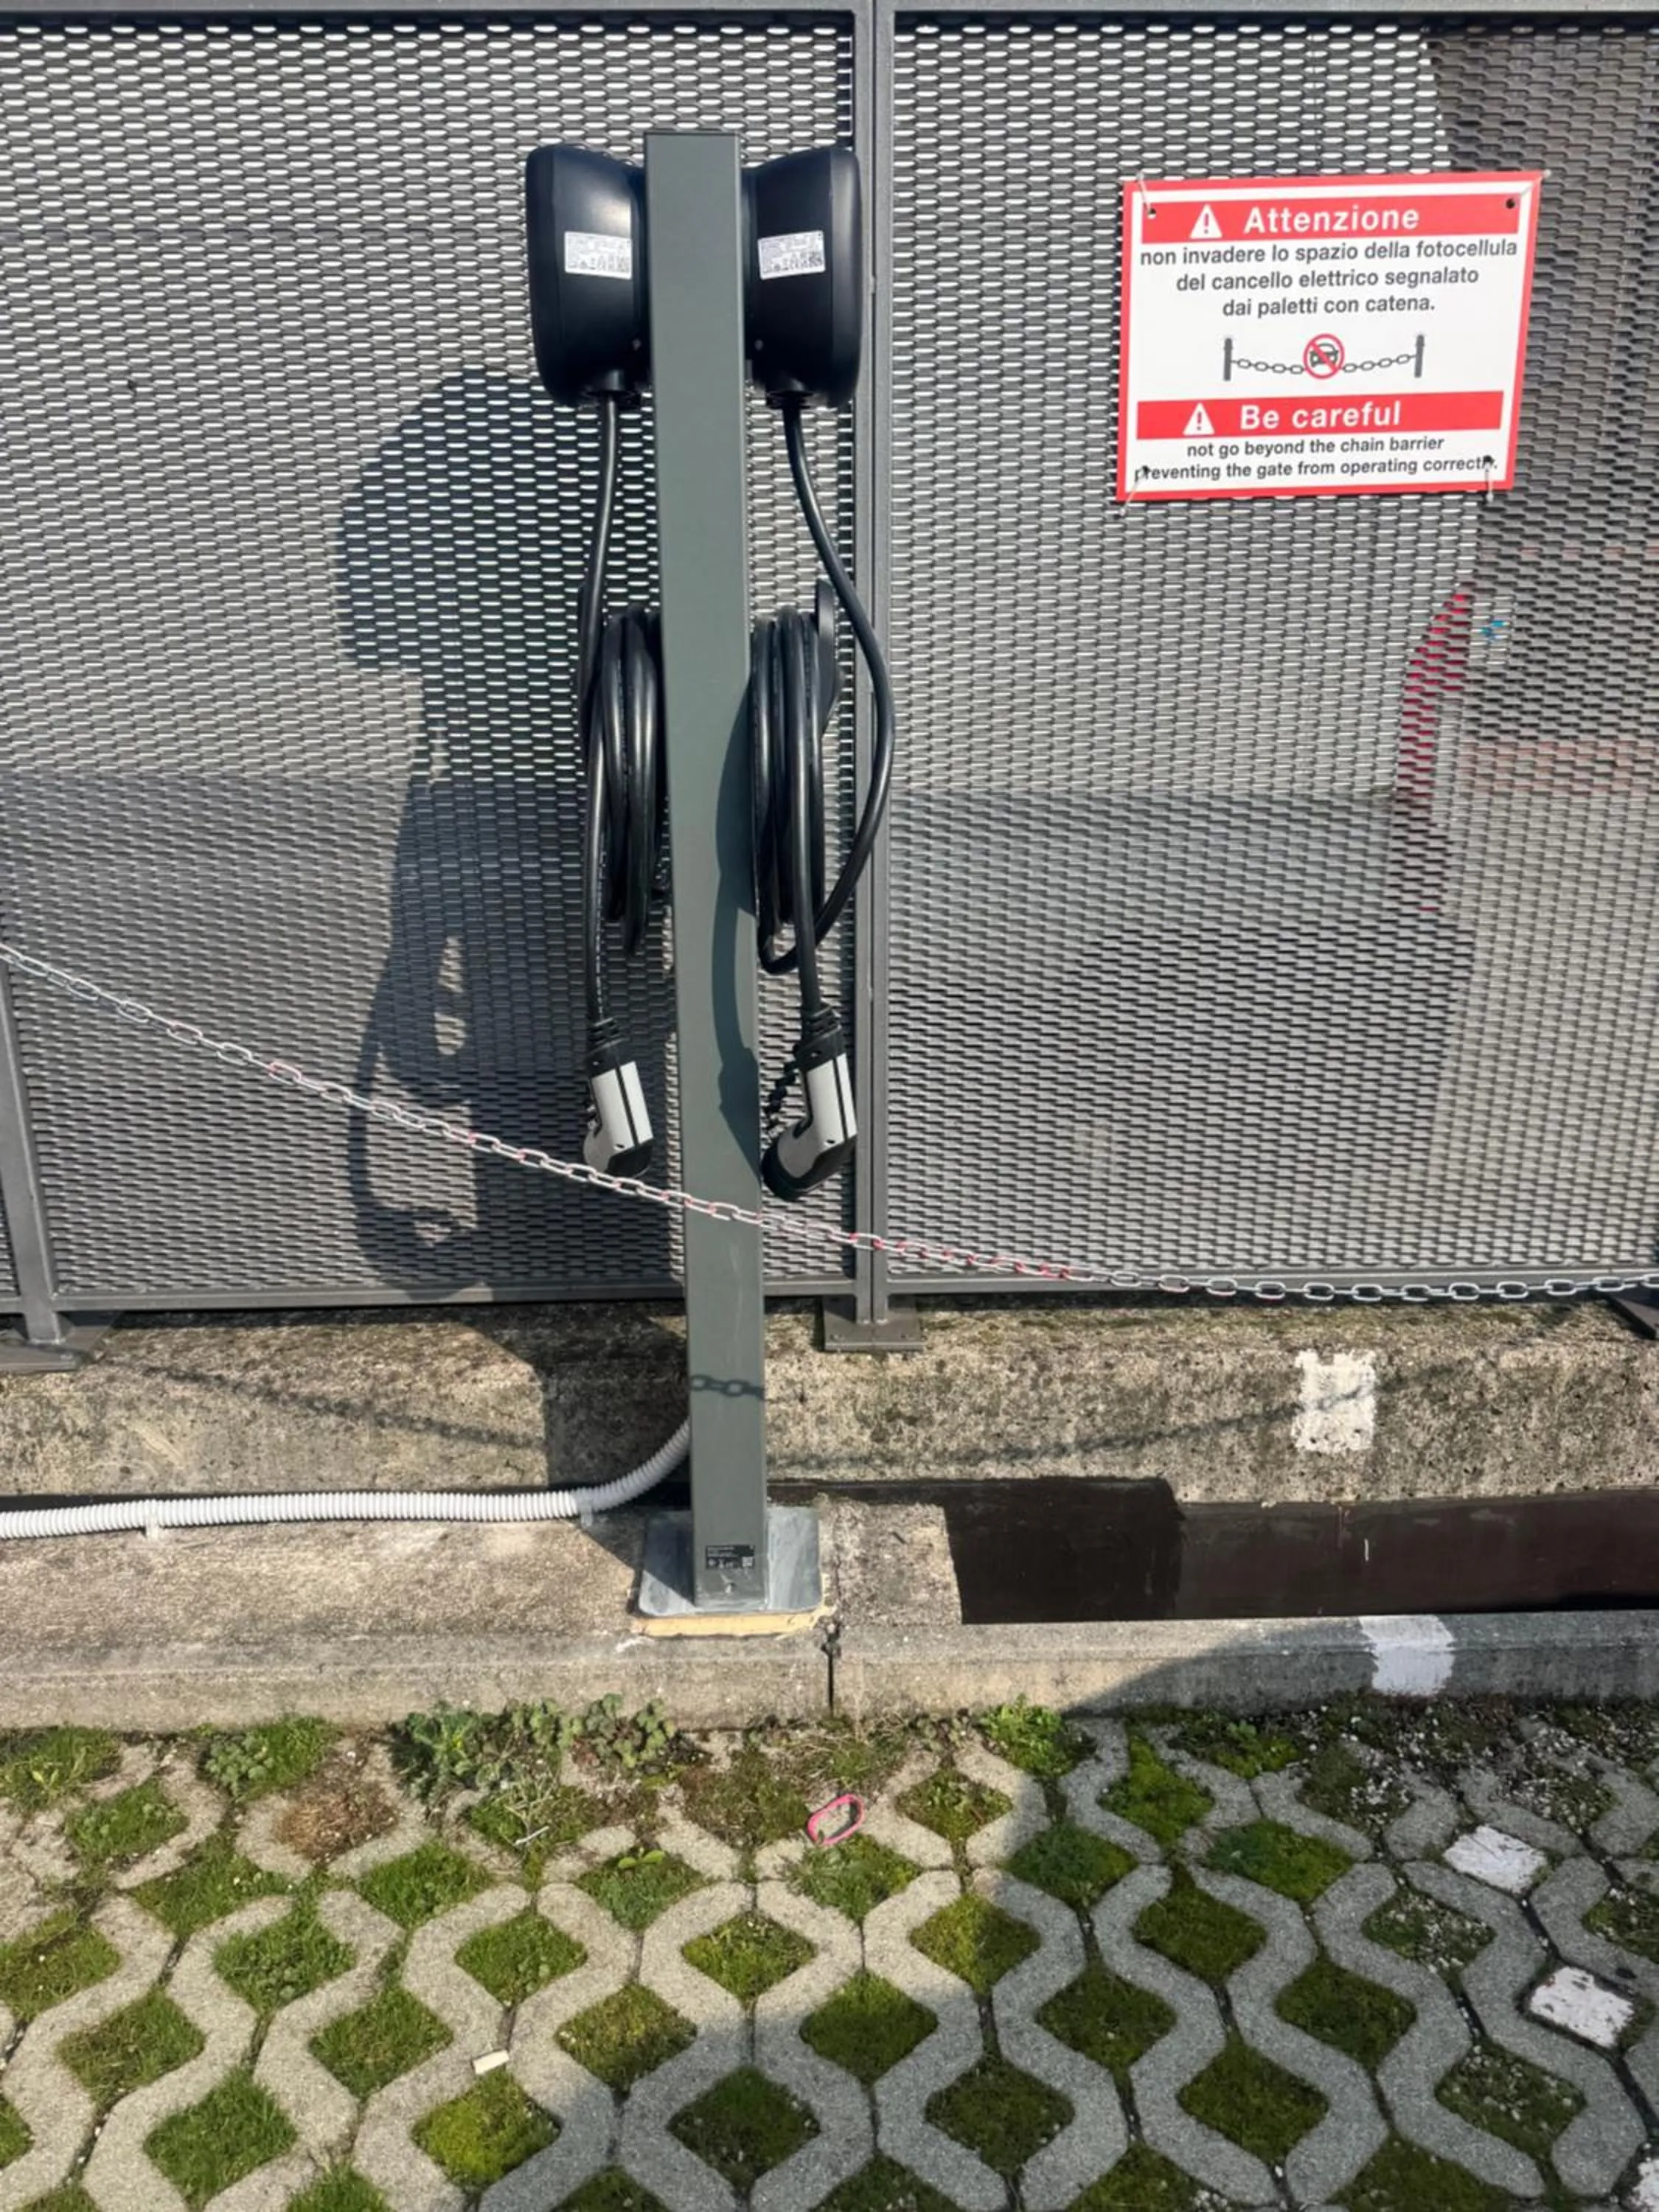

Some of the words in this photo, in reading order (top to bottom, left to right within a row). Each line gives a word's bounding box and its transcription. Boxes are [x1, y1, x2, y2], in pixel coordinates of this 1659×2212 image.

[1243, 205, 1420, 234] Attenzione
[1141, 251, 1177, 265] non
[1183, 246, 1265, 264] invadere
[1272, 244, 1290, 262] lo
[1295, 243, 1358, 264] spazio
[1364, 241, 1410, 258] della
[1416, 239, 1517, 257] fotocellula
[1177, 273, 1205, 291] del
[1211, 271, 1293, 290] cancello
[1299, 268, 1379, 287] elettrico
[1385, 266, 1479, 288] segnalato
[1222, 299, 1251, 316] dai
[1258, 296, 1318, 319] paletti
[1324, 299, 1359, 313] con
[1366, 296, 1436, 313] catena.
[1240, 405, 1280, 430] Be
[1292, 401, 1401, 428] careful
[1187, 443, 1214, 456] not
[1219, 444, 1239, 459] go
[1245, 439, 1304, 457] beyond
[1310, 439, 1335, 452] the
[1340, 437, 1384, 452] chain
[1389, 437, 1444, 451] barrier
[1226, 463, 1252, 476] the
[1256, 464, 1293, 479] gate
[1298, 460, 1335, 474] from
[1340, 458, 1418, 476] operating
